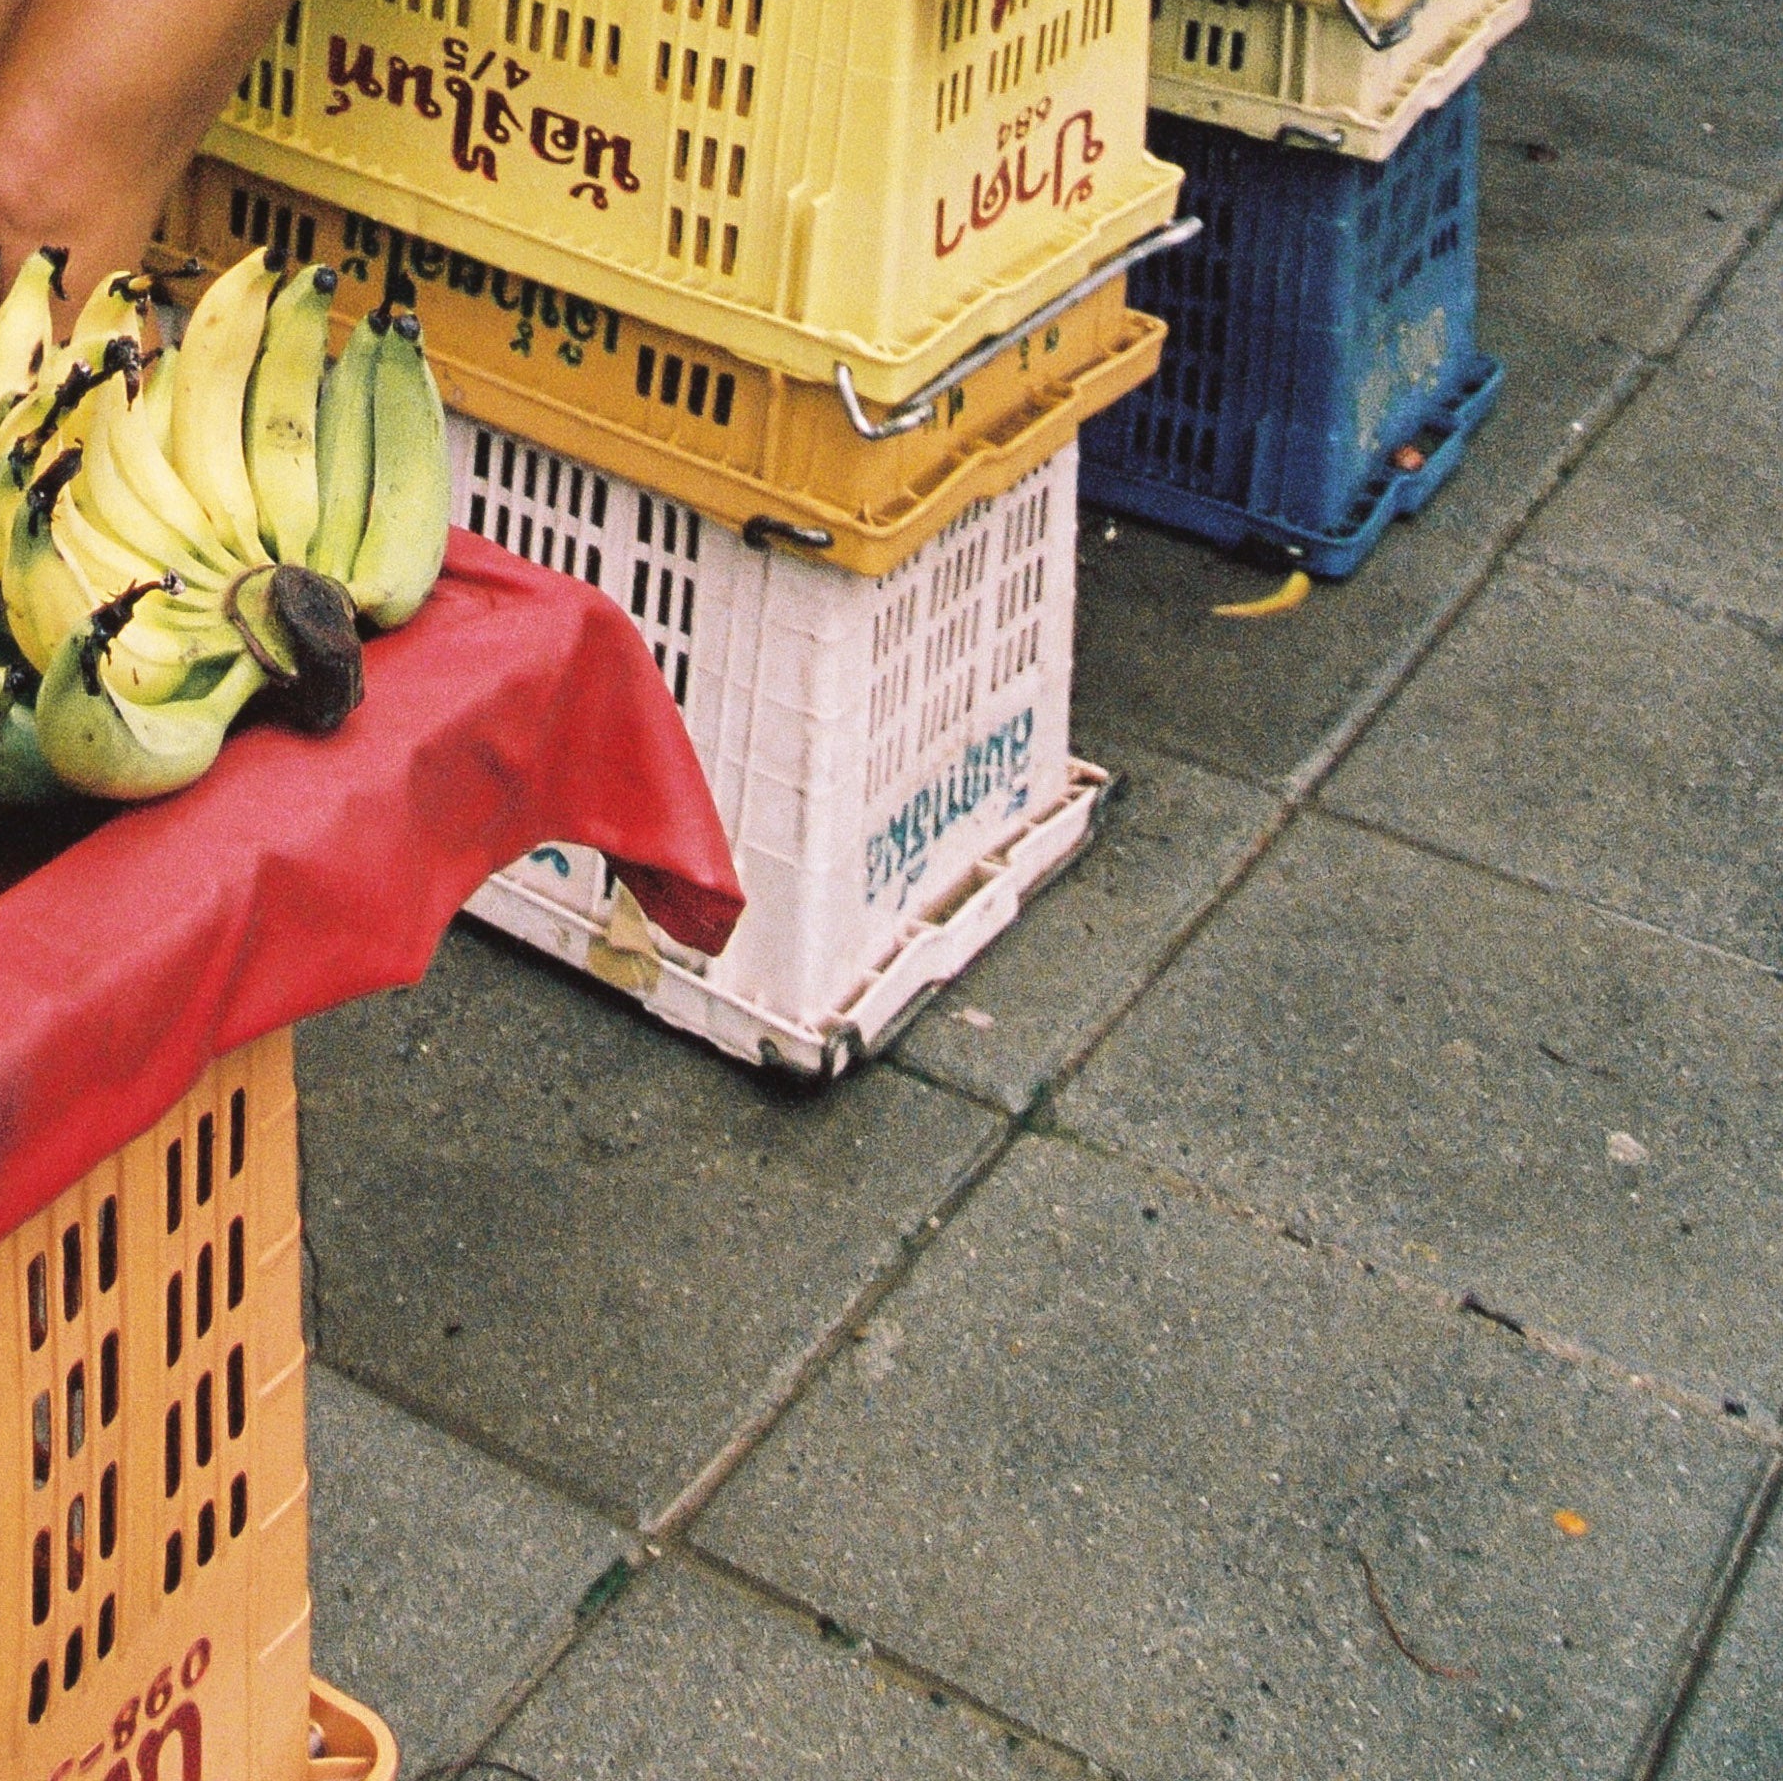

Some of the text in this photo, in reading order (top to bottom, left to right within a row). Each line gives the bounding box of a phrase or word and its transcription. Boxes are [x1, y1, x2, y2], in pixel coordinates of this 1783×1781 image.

[324, 35, 640, 210] น้องไนท์
[443, 37, 531, 90] 4/5
[49, 1637, 212, 1781] 098-
